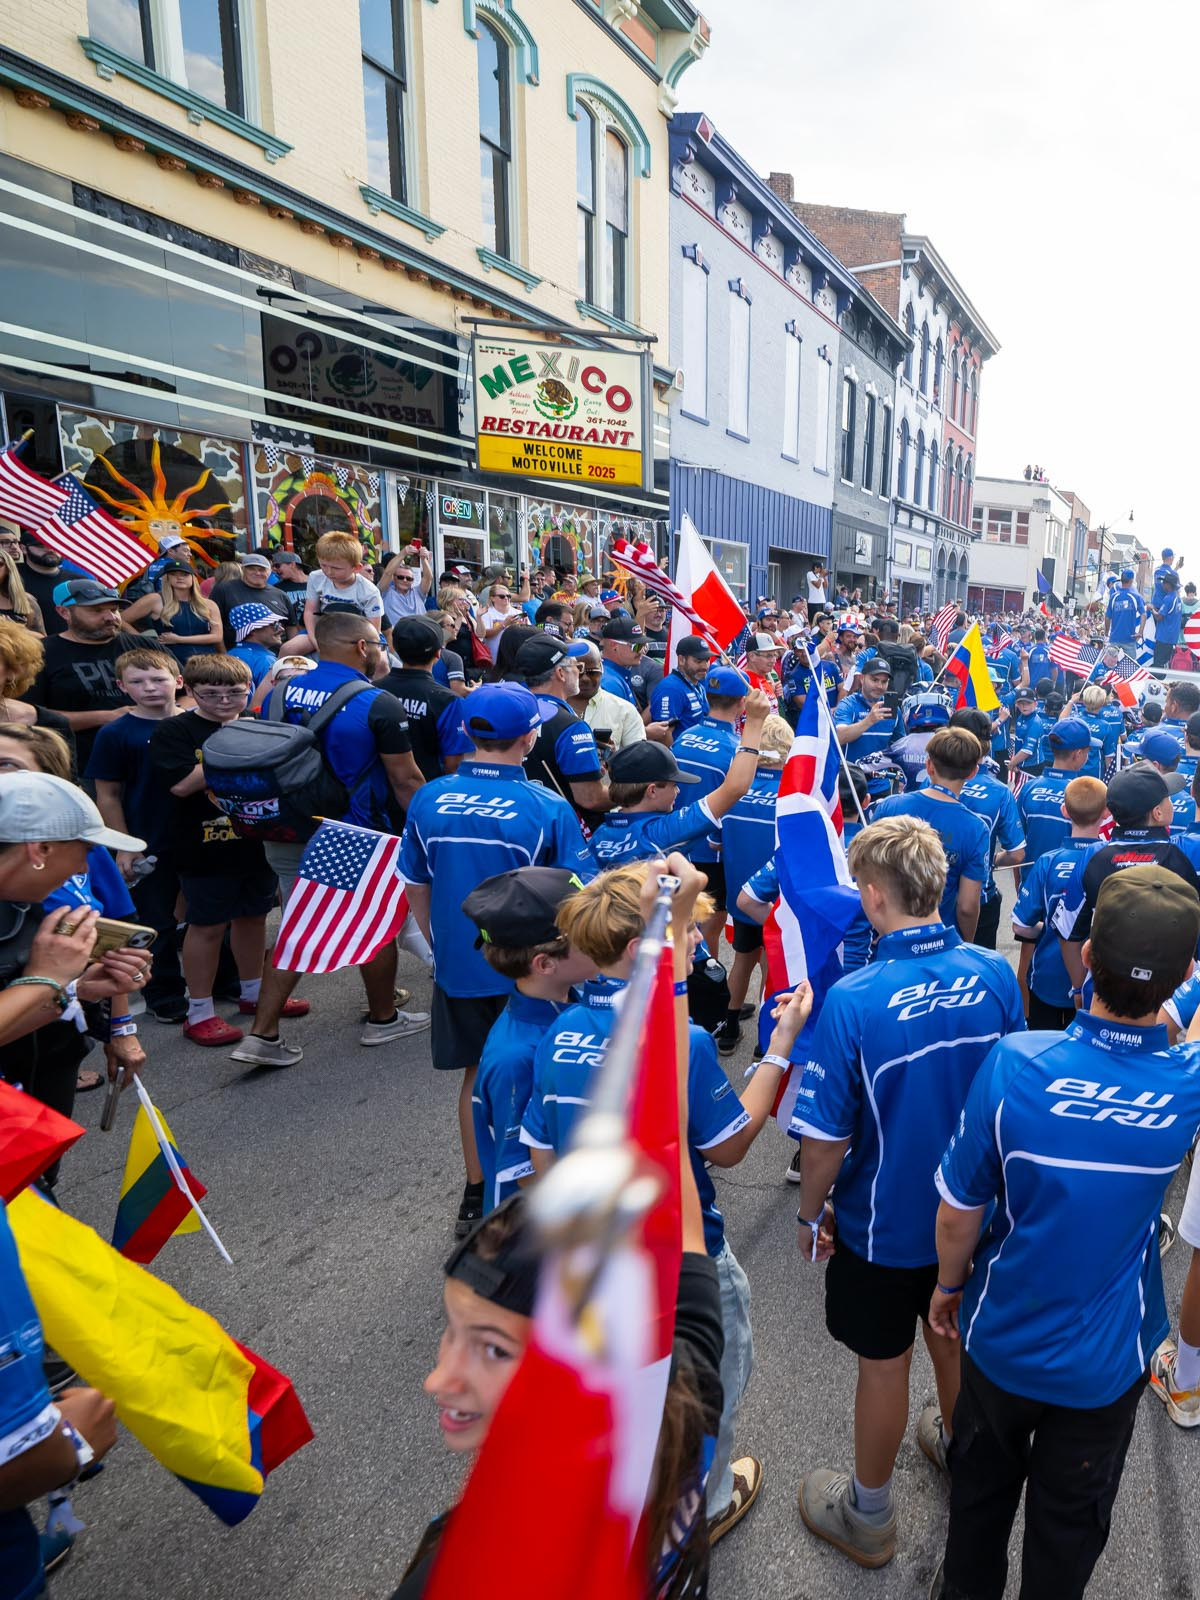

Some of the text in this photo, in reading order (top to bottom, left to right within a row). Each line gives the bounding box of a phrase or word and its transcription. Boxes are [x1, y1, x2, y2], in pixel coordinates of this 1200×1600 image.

[479, 351, 634, 414] MEXICO
[481, 416, 635, 447] RESTAURANT
[586, 416, 628, 428] 361-1042
[523, 443, 583, 461] WELCOME
[512, 456, 616, 479] MOTOVILLE 2025
[285, 685, 346, 712] YAMA
[399, 697, 428, 717] AHA
[681, 733, 719, 746] BLU
[681, 740, 720, 753] CRU
[477, 768, 500, 777] YAMAHA
[435, 792, 516, 808] BLU
[436, 804, 518, 820] CRU
[919, 938, 945, 951] YAMAHA
[592, 995, 616, 1004] YAMAH
[887, 975, 980, 1008] BLU
[897, 990, 987, 1021] CRU
[1110, 1030, 1142, 1045] YAMAHA
[552, 1048, 606, 1067] CR
[805, 1060, 826, 1079] MAHA
[1045, 1077, 1174, 1108] BLU
[1050, 1100, 1177, 1129] CRU
